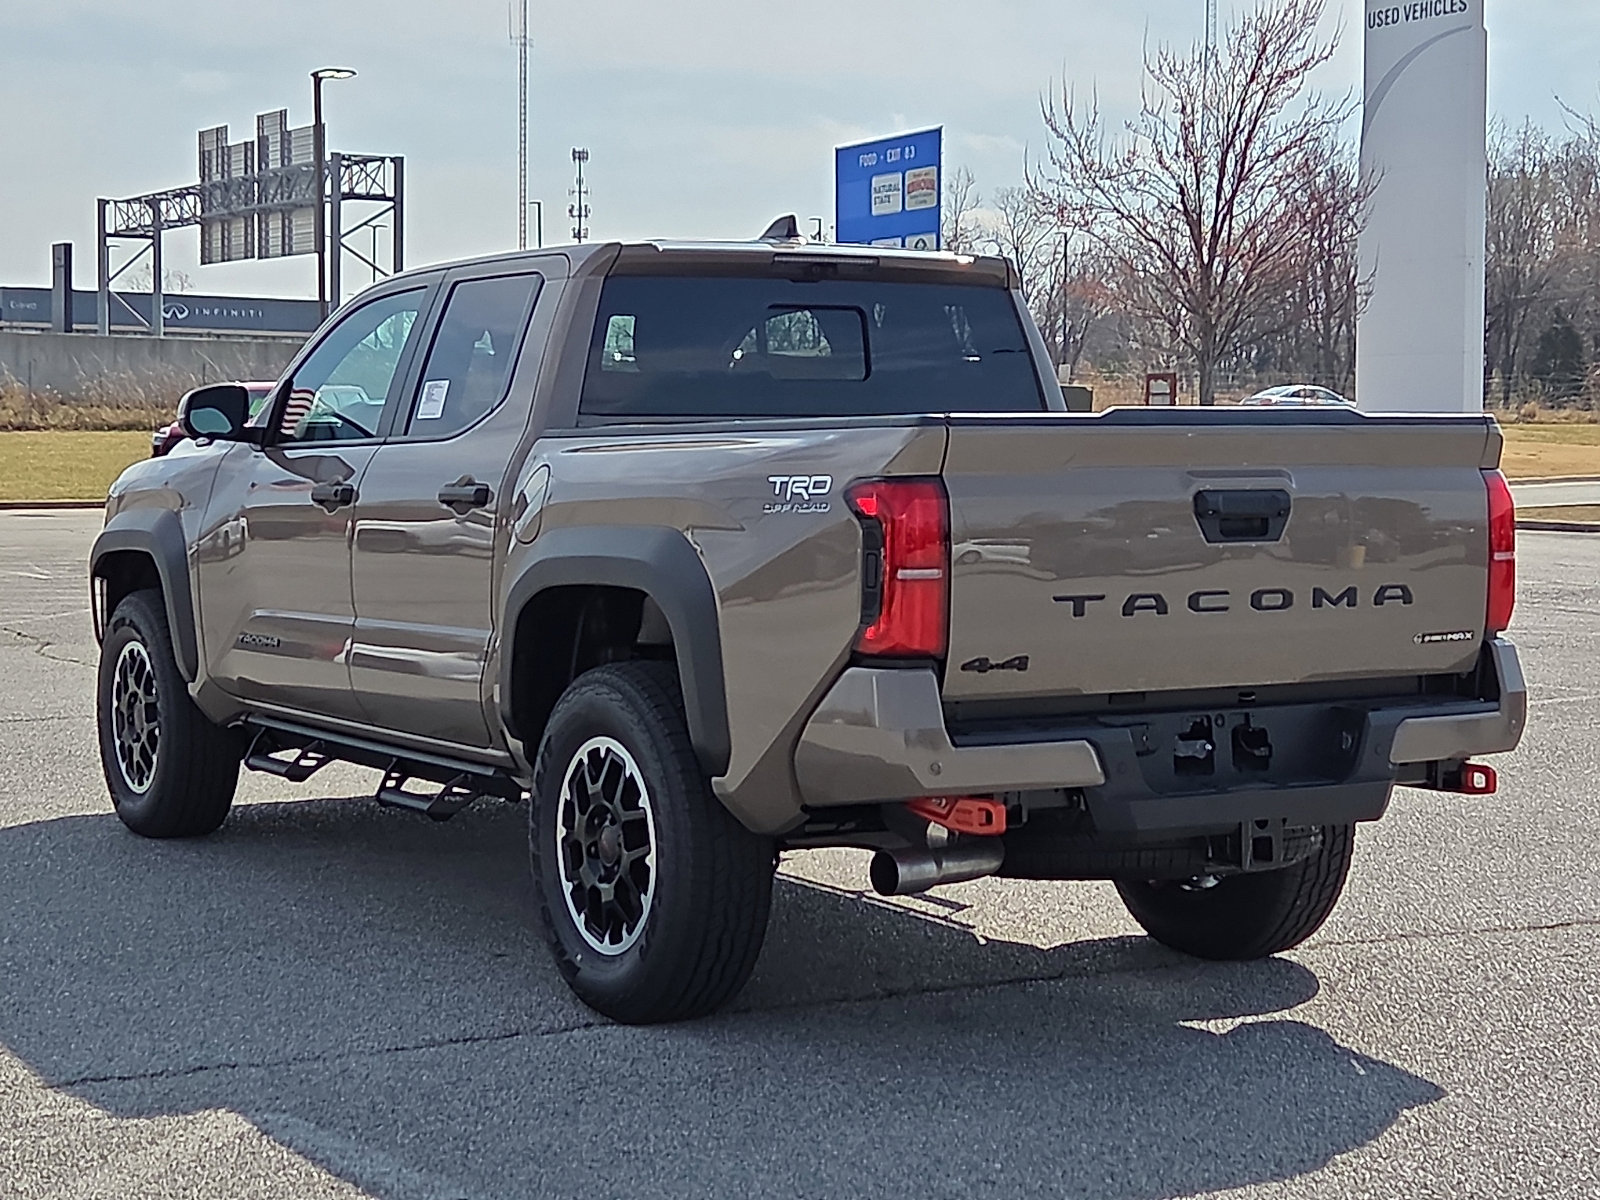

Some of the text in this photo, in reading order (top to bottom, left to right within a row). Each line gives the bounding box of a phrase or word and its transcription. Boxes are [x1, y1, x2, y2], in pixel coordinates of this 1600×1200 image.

[1367, 0, 1468, 30] USED VEHICLES
[859, 152, 878, 168] FOOD
[886, 148, 901, 163] EXIT
[195, 307, 263, 318] INFINITI
[768, 475, 832, 501] TRD
[1052, 584, 1414, 618] TACOMA
